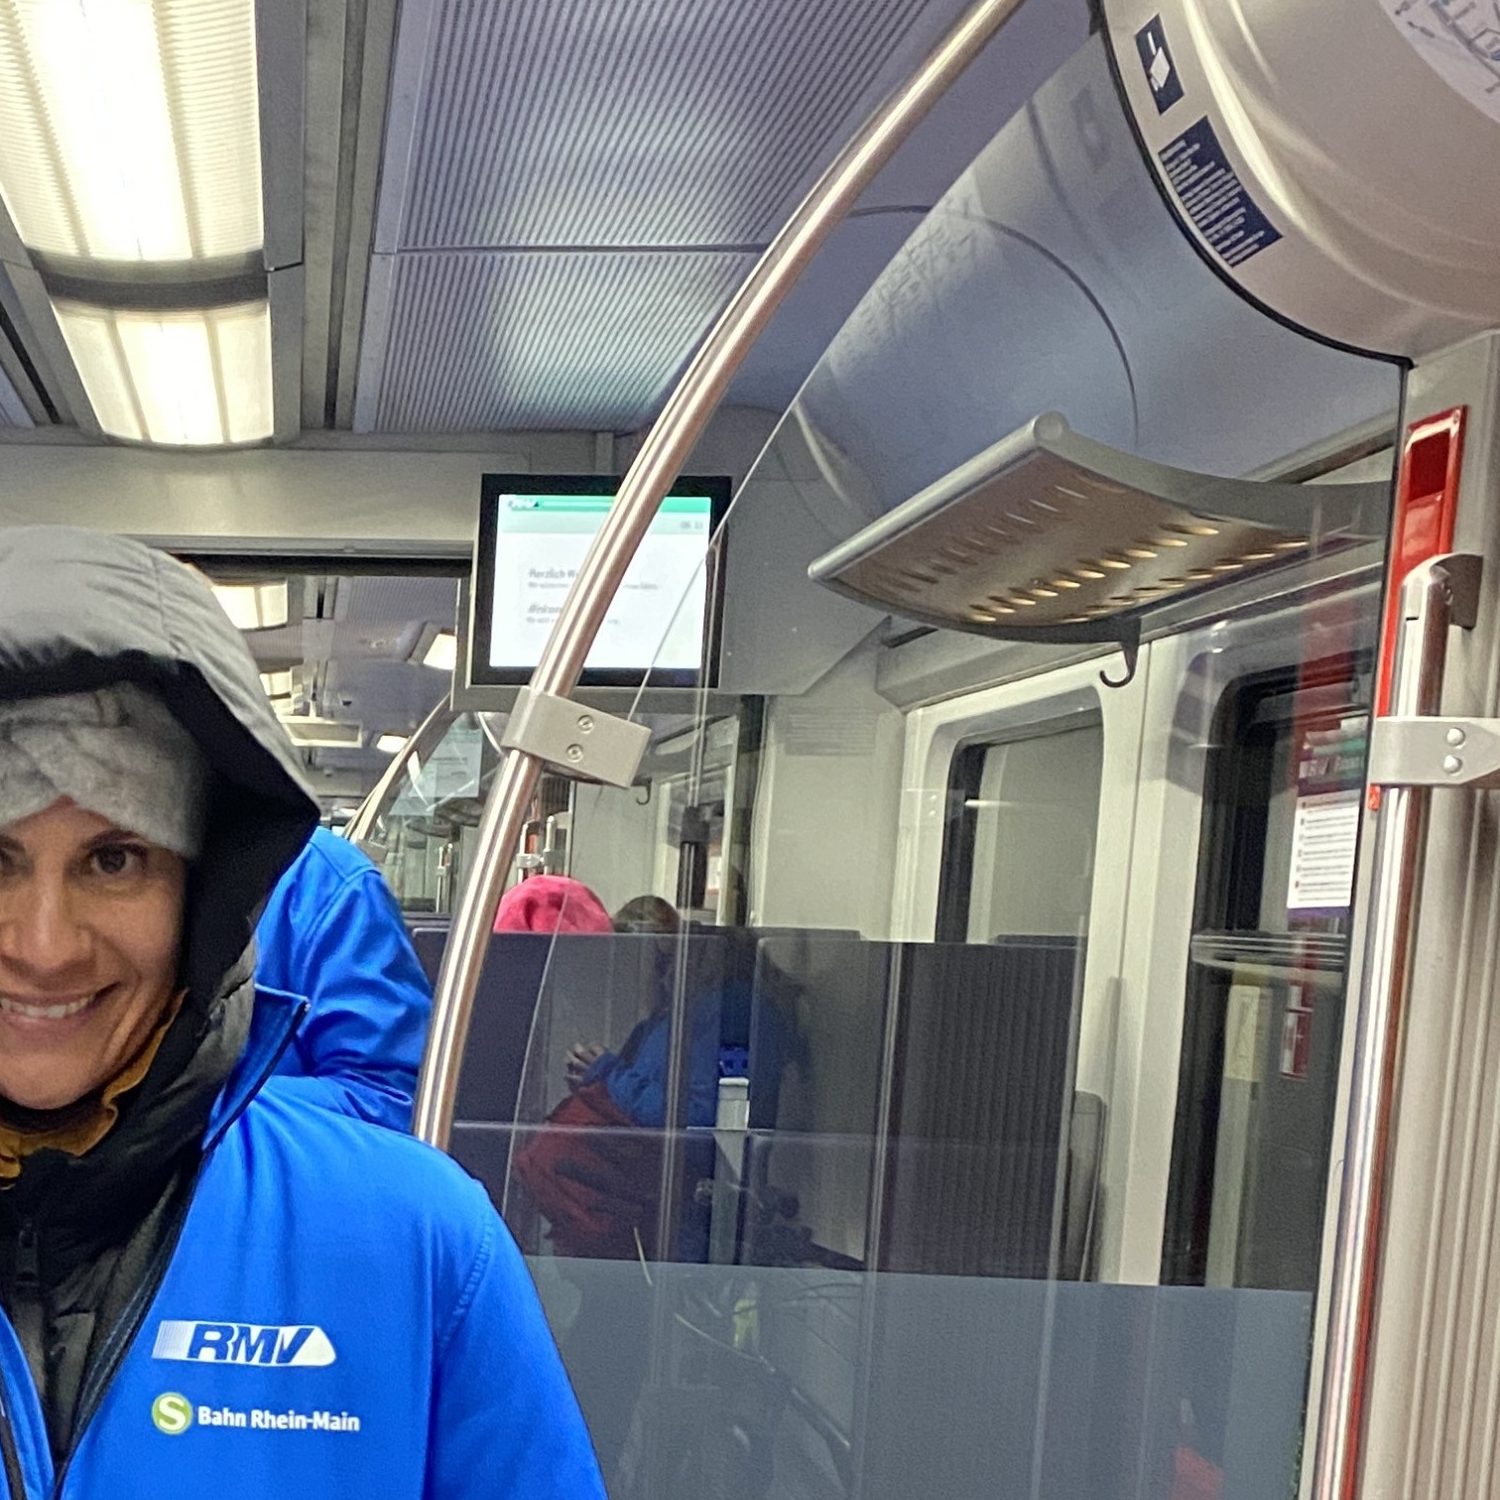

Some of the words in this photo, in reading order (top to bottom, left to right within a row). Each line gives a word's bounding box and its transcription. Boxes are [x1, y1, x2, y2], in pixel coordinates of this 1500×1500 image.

[187, 1324, 316, 1364] RMV
[158, 1395, 186, 1431] S
[198, 1406, 246, 1428] Bahn
[251, 1410, 361, 1432] Rhein-Main
